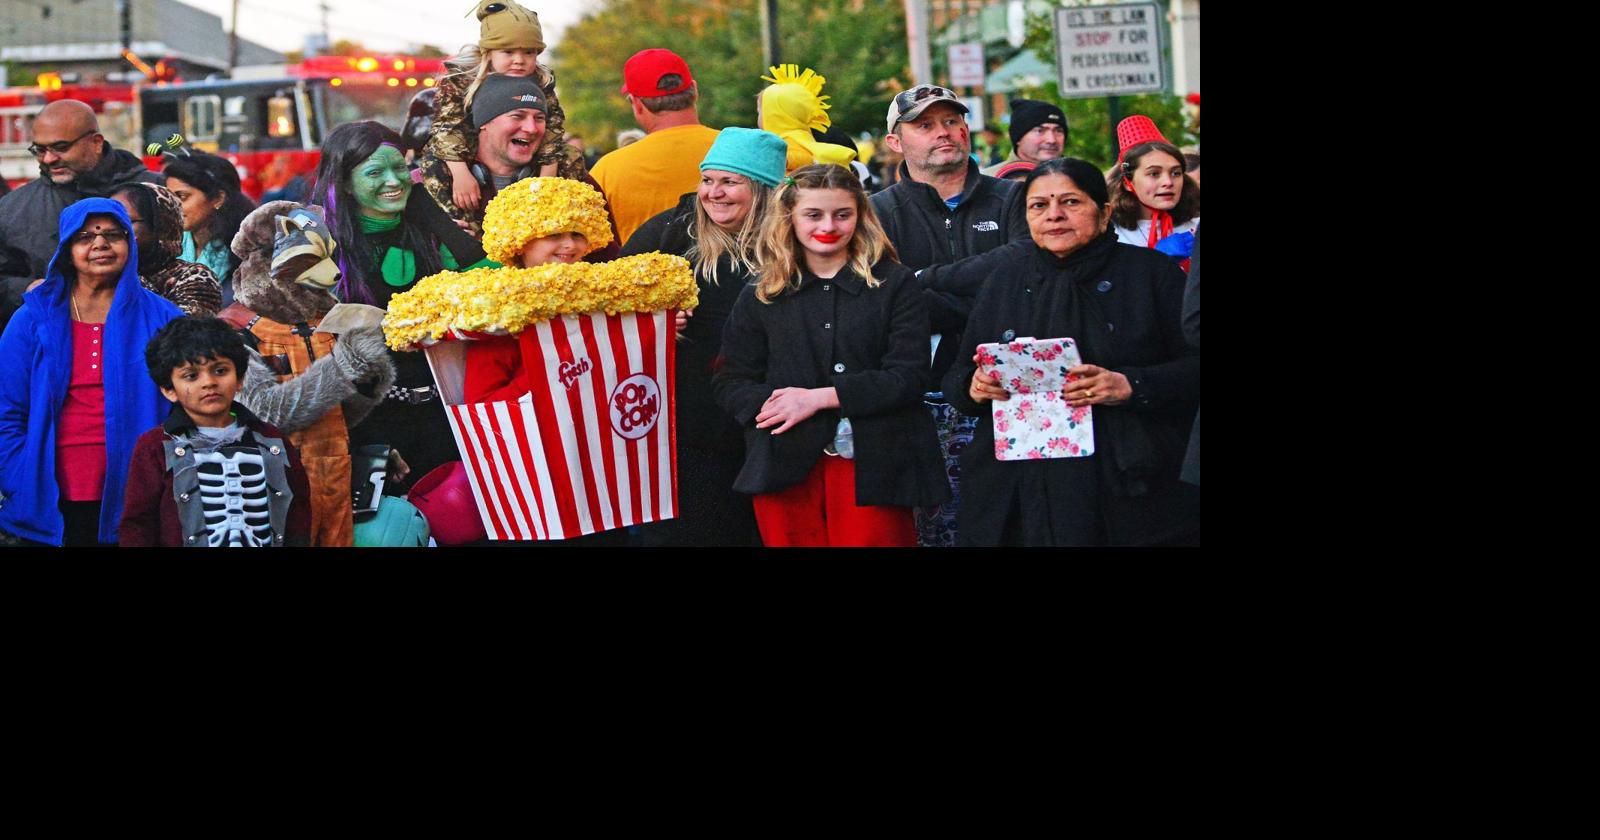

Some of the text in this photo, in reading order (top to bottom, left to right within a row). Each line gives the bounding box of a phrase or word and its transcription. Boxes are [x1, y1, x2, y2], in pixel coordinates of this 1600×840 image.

[1094, 10, 1112, 24] THE
[1121, 9, 1146, 23] LAW
[1075, 29, 1148, 47] STOP FOR
[1070, 51, 1150, 69] PEDESTRIANS
[1067, 73, 1156, 89] IN CROSSWALK
[559, 357, 589, 390] fresh
[615, 383, 647, 415] POP
[620, 393, 657, 433] CORN
